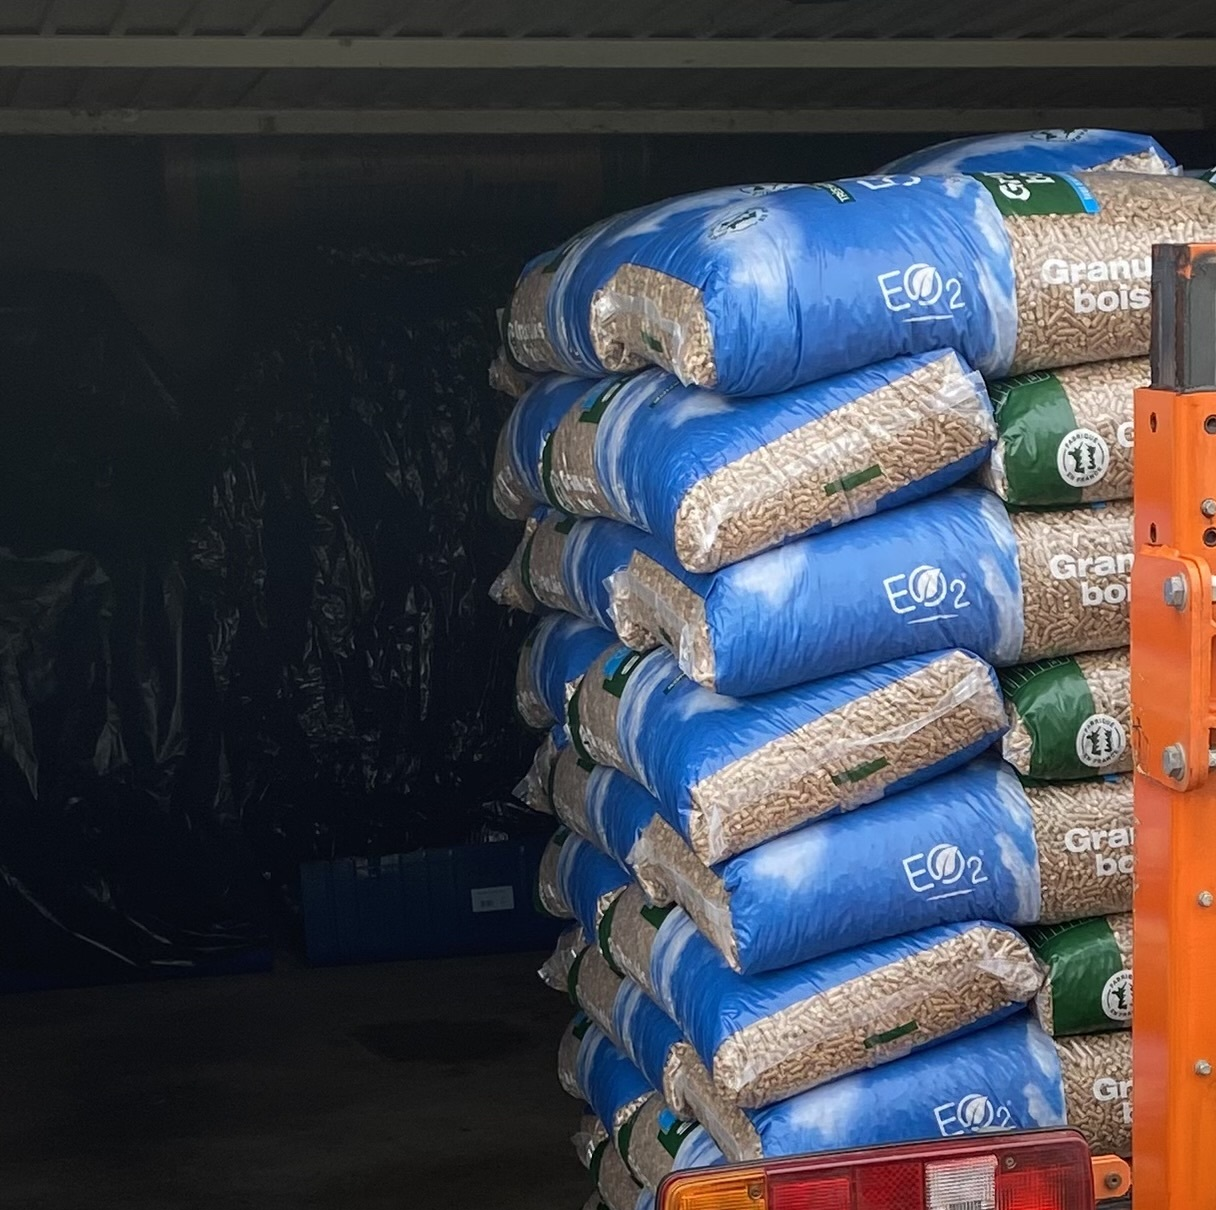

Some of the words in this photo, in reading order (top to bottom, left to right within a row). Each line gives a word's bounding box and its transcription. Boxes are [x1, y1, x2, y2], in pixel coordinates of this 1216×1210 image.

[877, 263, 966, 312] EO2
[1073, 284, 1151, 314] bois
[883, 565, 971, 615] EO2
[902, 843, 989, 894] EO2
